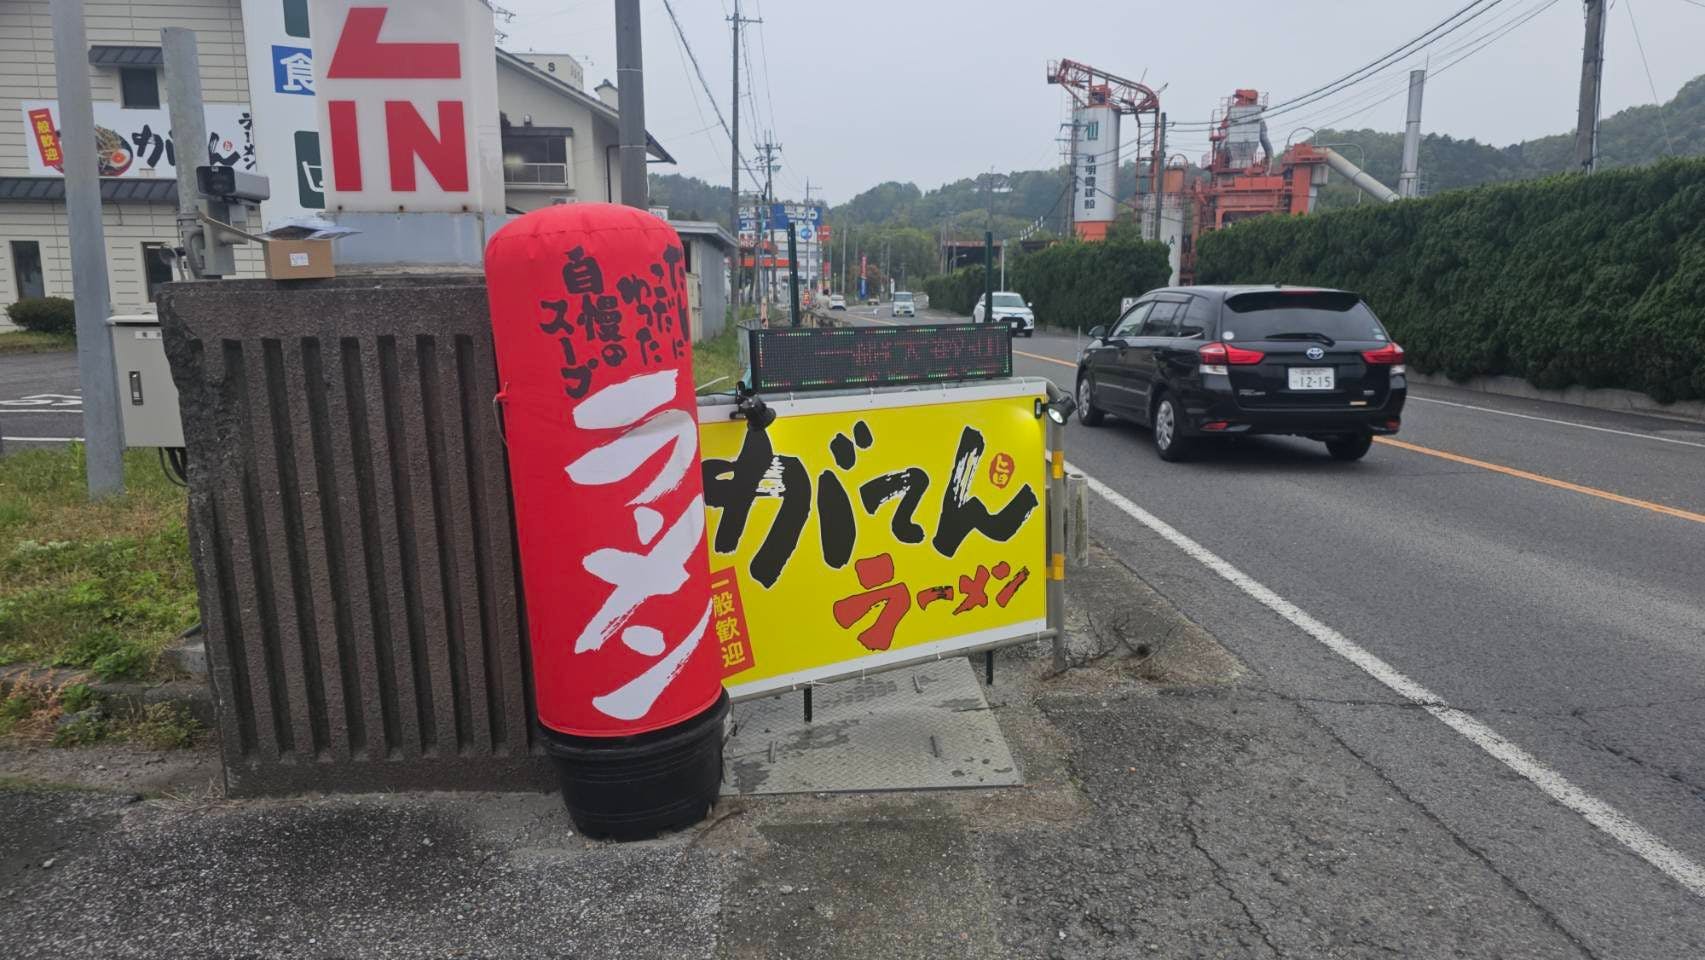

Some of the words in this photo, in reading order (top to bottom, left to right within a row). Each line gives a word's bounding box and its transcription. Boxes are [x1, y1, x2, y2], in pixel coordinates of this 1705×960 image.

[328, 100, 468, 192] IN
[540, 299, 599, 400] スープ
[562, 246, 628, 367] 自慢の
[701, 420, 1040, 589] がてん
[711, 578, 746, 668] 一般歓迎
[833, 552, 1030, 651] ラーメン
